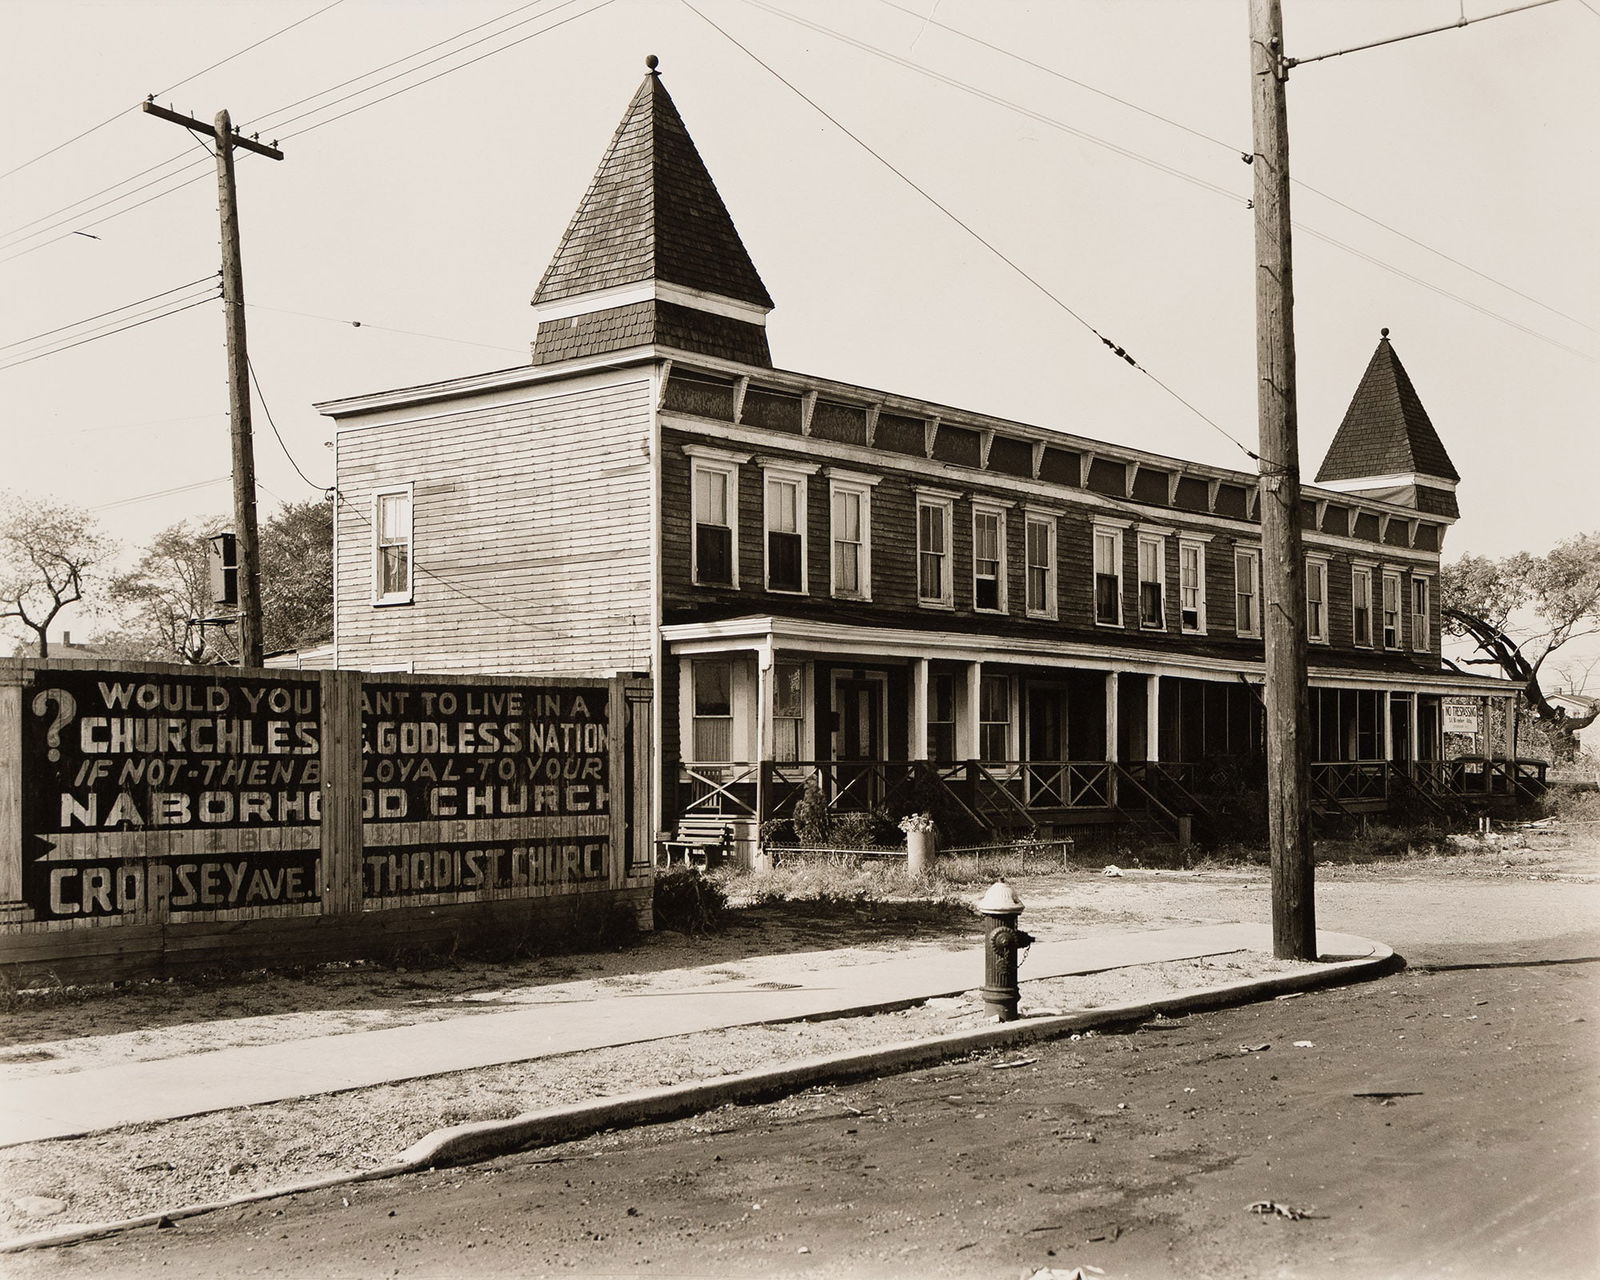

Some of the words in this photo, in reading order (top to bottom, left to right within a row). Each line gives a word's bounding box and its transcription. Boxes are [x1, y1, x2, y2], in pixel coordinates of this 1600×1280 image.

[98, 681, 230, 712] WOULD
[240, 686, 313, 715] YOU
[361, 690, 410, 716] ANT
[421, 691, 458, 716] TO
[467, 692, 523, 716] LIVE
[537, 694, 561, 717] IN
[570, 695, 591, 718] A
[80, 716, 320, 755] CHURCHLES
[377, 721, 523, 755] GODLESS
[529, 723, 609, 754] NATION
[74, 758, 113, 787] IF
[300, 758, 321, 786] B
[527, 757, 603, 780] YOUR
[50, 861, 248, 915] CROPSEY
[246, 866, 313, 901] AVE.
[315, 849, 506, 898] THODIST
